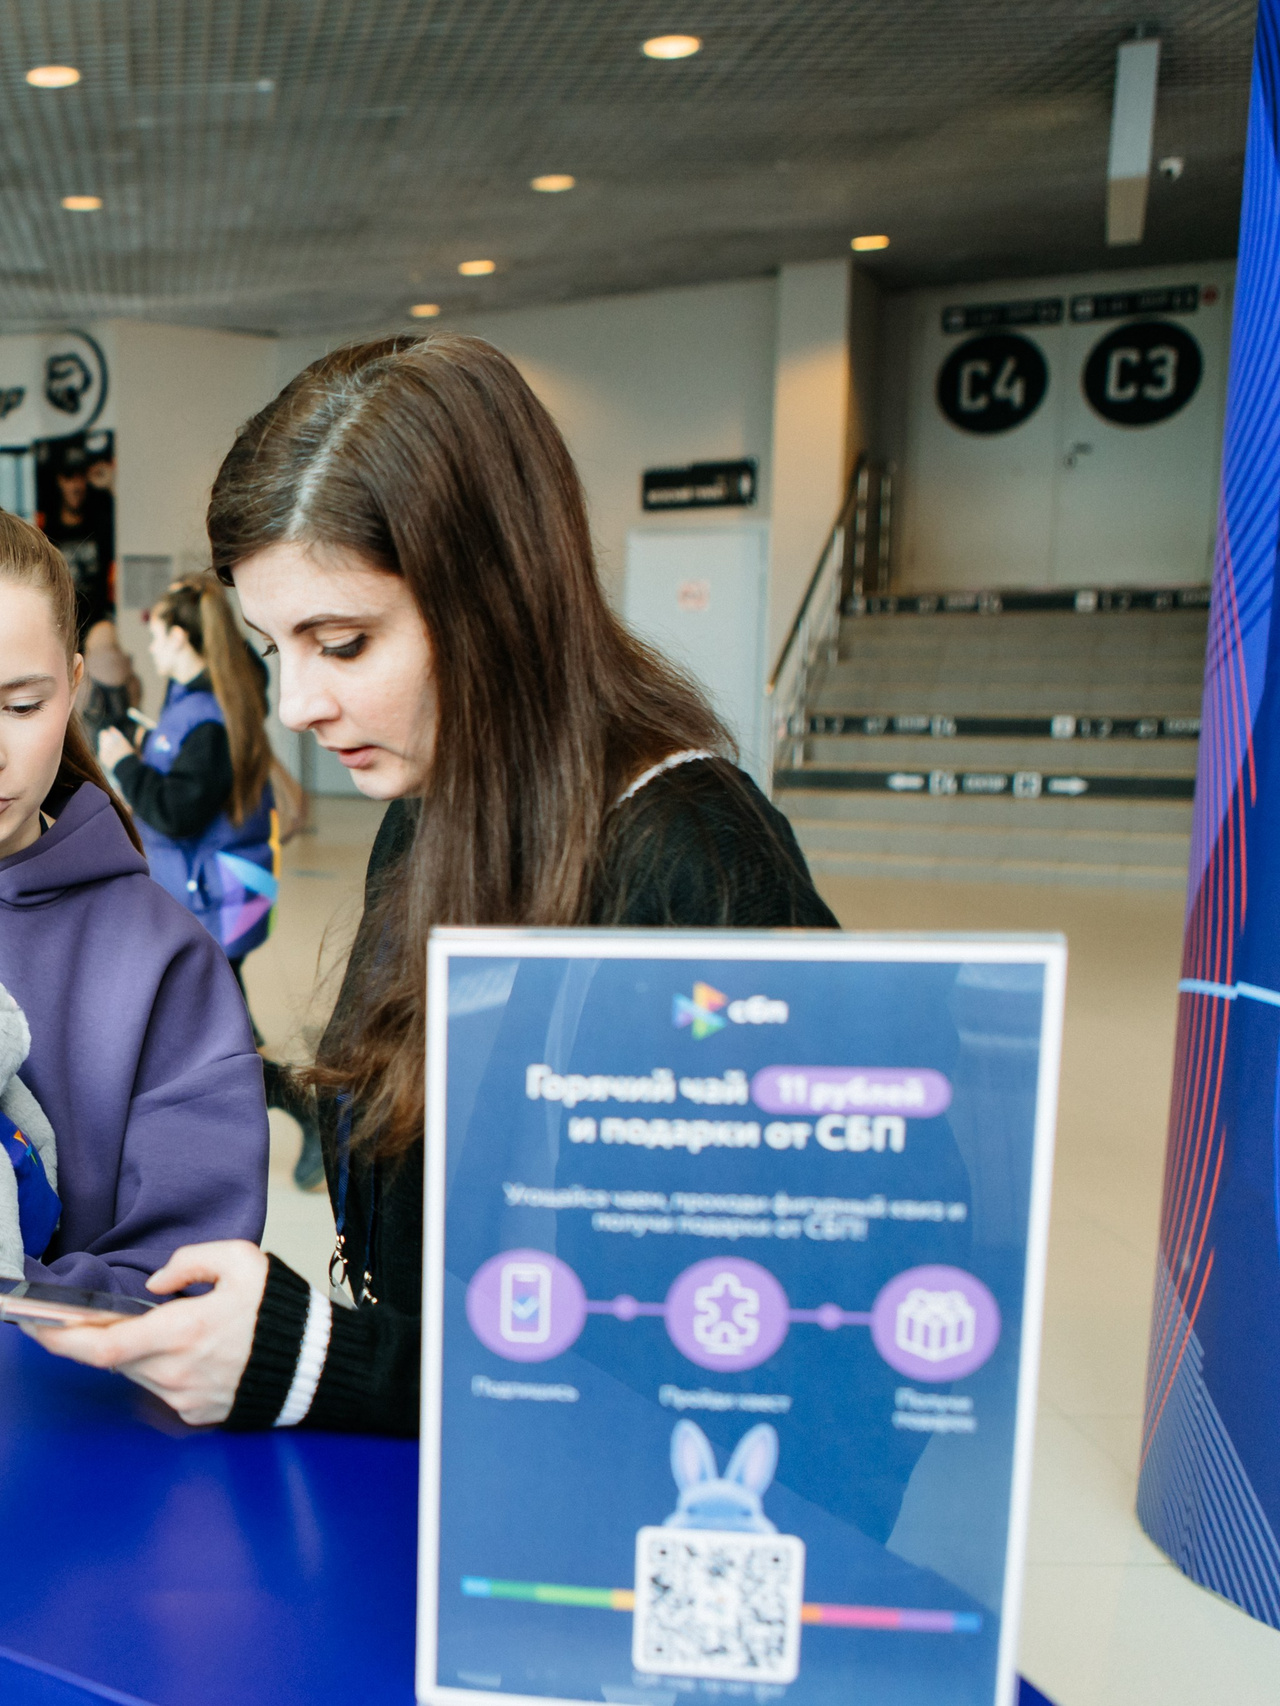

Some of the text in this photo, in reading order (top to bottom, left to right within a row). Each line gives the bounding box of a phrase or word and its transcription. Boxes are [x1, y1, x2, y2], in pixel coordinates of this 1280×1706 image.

[958, 355, 1026, 413] C4
[1105, 345, 1179, 401] C3
[526, 1063, 926, 1111] Горячий чай 11 рублей
[568, 1113, 906, 1154] и подарки от СБП
